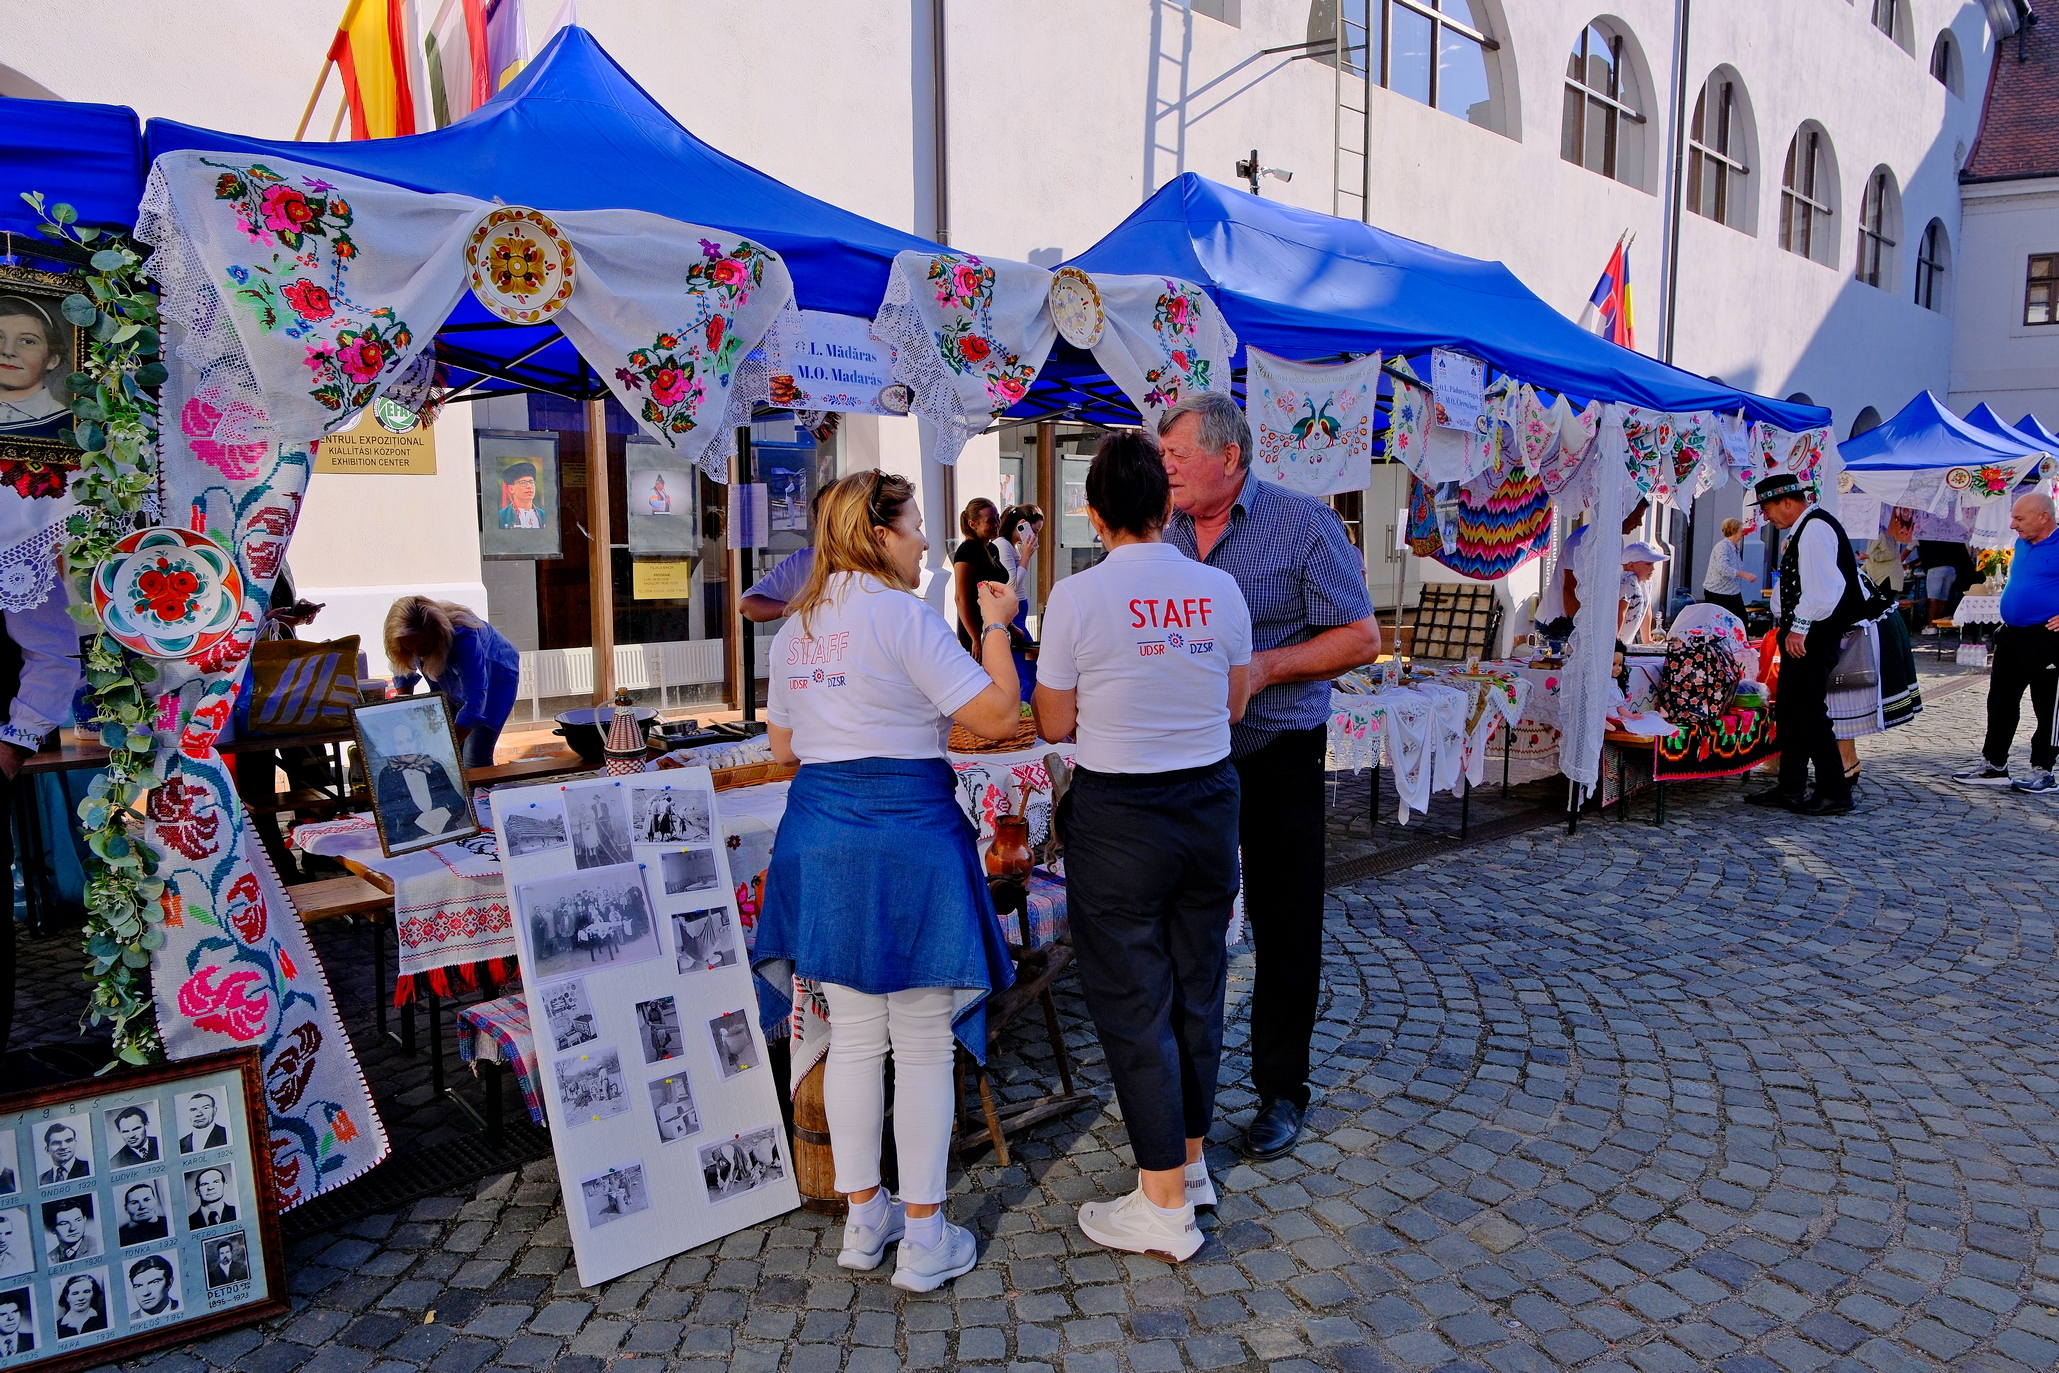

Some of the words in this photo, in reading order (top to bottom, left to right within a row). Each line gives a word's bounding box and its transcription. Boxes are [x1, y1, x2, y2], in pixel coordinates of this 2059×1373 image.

[826, 343, 877, 363] Mădăras
[797, 364, 828, 381] M.O.
[831, 367, 883, 387] Madarás
[320, 435, 357, 445] ENTRUL
[359, 435, 424, 447] EXPOZIȚIONAL
[328, 446, 372, 455] KIÁLLÍTÁSI
[374, 446, 411, 456] KÖZPONT
[331, 457, 377, 466] EXHIBITION
[378, 458, 410, 467] CENTER
[1128, 598, 1213, 629] STAFF
[786, 630, 850, 666] STAFF
[1139, 644, 1166, 656] UDSR
[1189, 642, 1214, 654] DZSR
[789, 679, 809, 690] UDSR
[827, 675, 847, 688] DZSR
[217, 1150, 234, 1159] 1924
[110, 1170, 139, 1183] LUDVIK
[148, 1165, 166, 1174] 1922
[41, 1186, 71, 1198] ONDRO
[78, 1180, 97, 1190] 1920
[1, 1196, 20, 1207] 1918
[191, 1229, 217, 1241] PETRO
[224, 1223, 243, 1233] 1934
[125, 1246, 151, 1258] TONKA
[159, 1238, 178, 1249] 1932
[48, 1262, 73, 1276] LEVIT
[85, 1256, 103, 1267] 1930
[207, 1284, 239, 1300] PETRO
[166, 1312, 184, 1322] 1941
